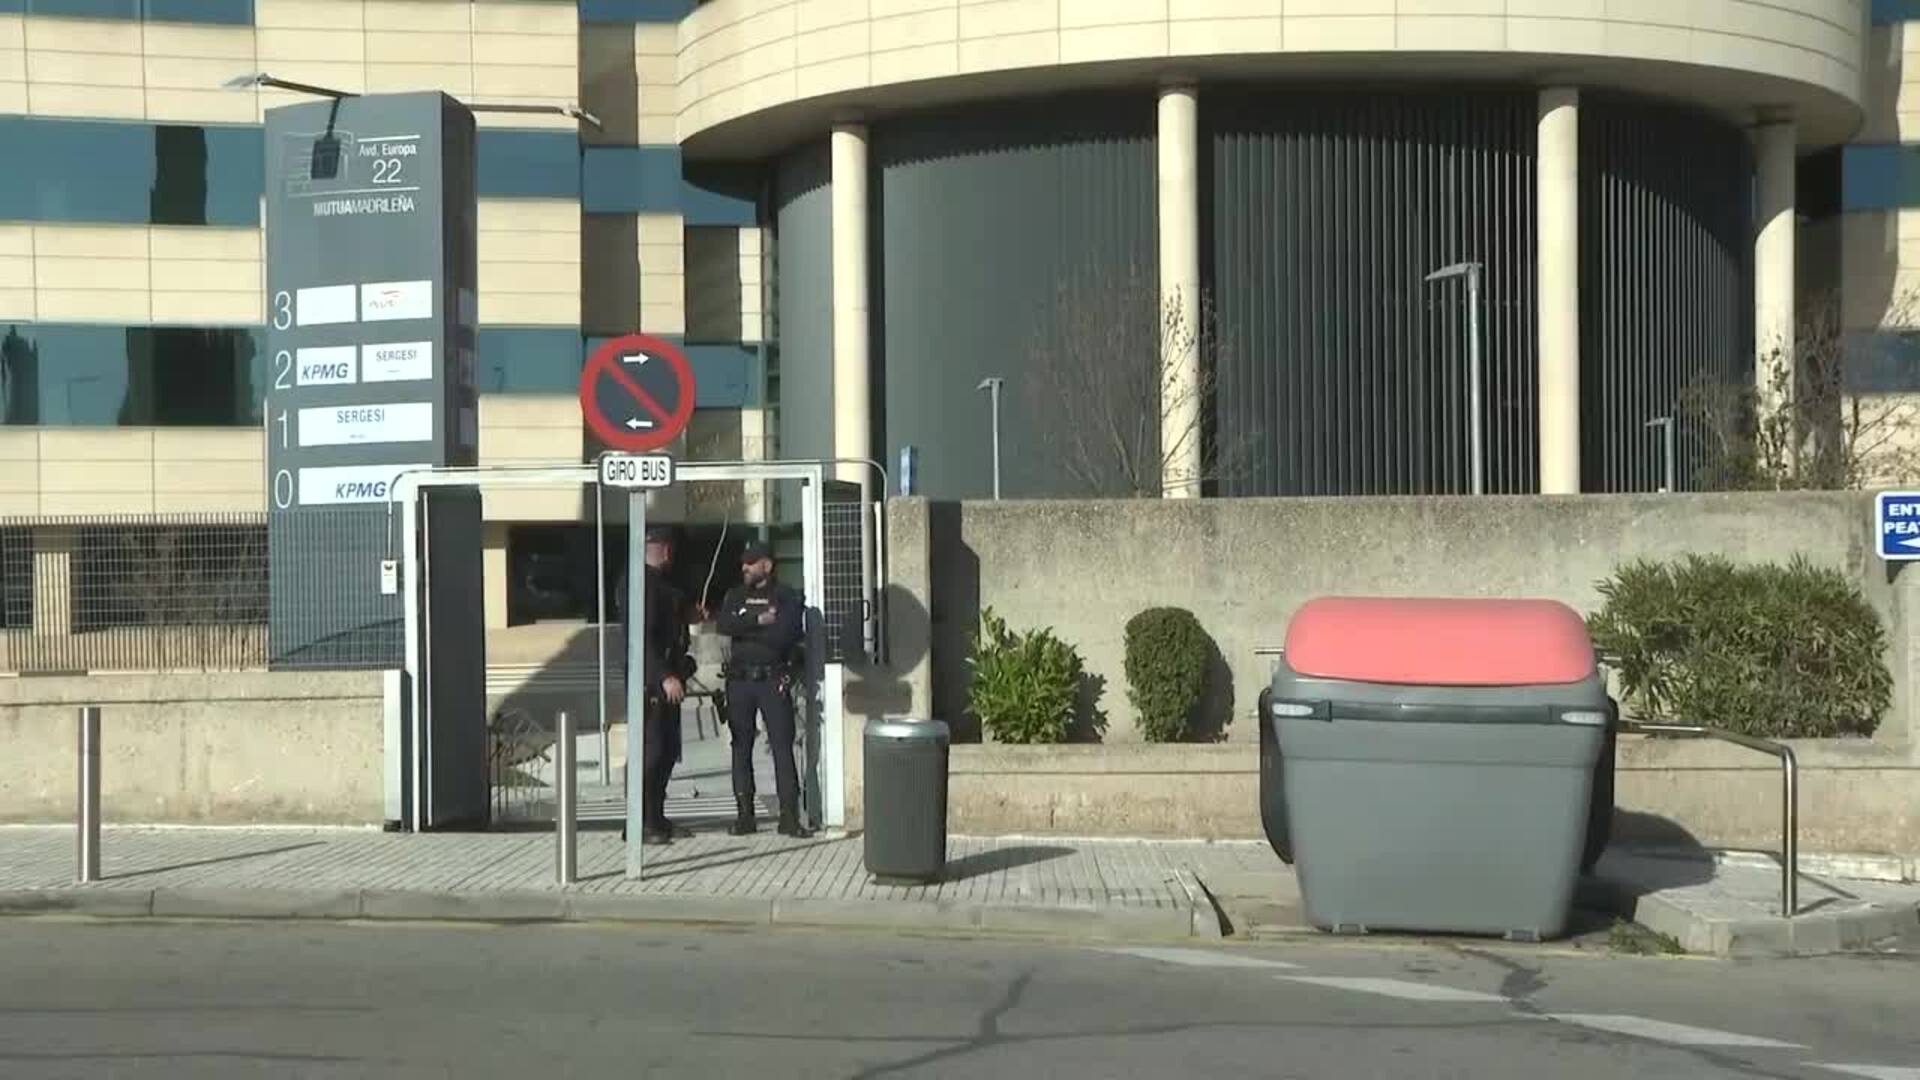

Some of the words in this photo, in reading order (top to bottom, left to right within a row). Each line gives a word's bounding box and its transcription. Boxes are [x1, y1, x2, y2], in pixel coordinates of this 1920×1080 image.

[382, 144, 417, 156] Europa
[372, 158, 402, 184] 22
[274, 290, 292, 330] 3
[275, 350, 292, 389] 2
[301, 362, 348, 380] KPMG
[336, 408, 385, 423] SERGESI
[277, 409, 288, 449] 1
[607, 460, 636, 481] GIRO
[642, 460, 667, 481] BUS
[275, 469, 293, 509] 0
[335, 481, 387, 498] KPMG
[1884, 521, 1920, 534] PEA
